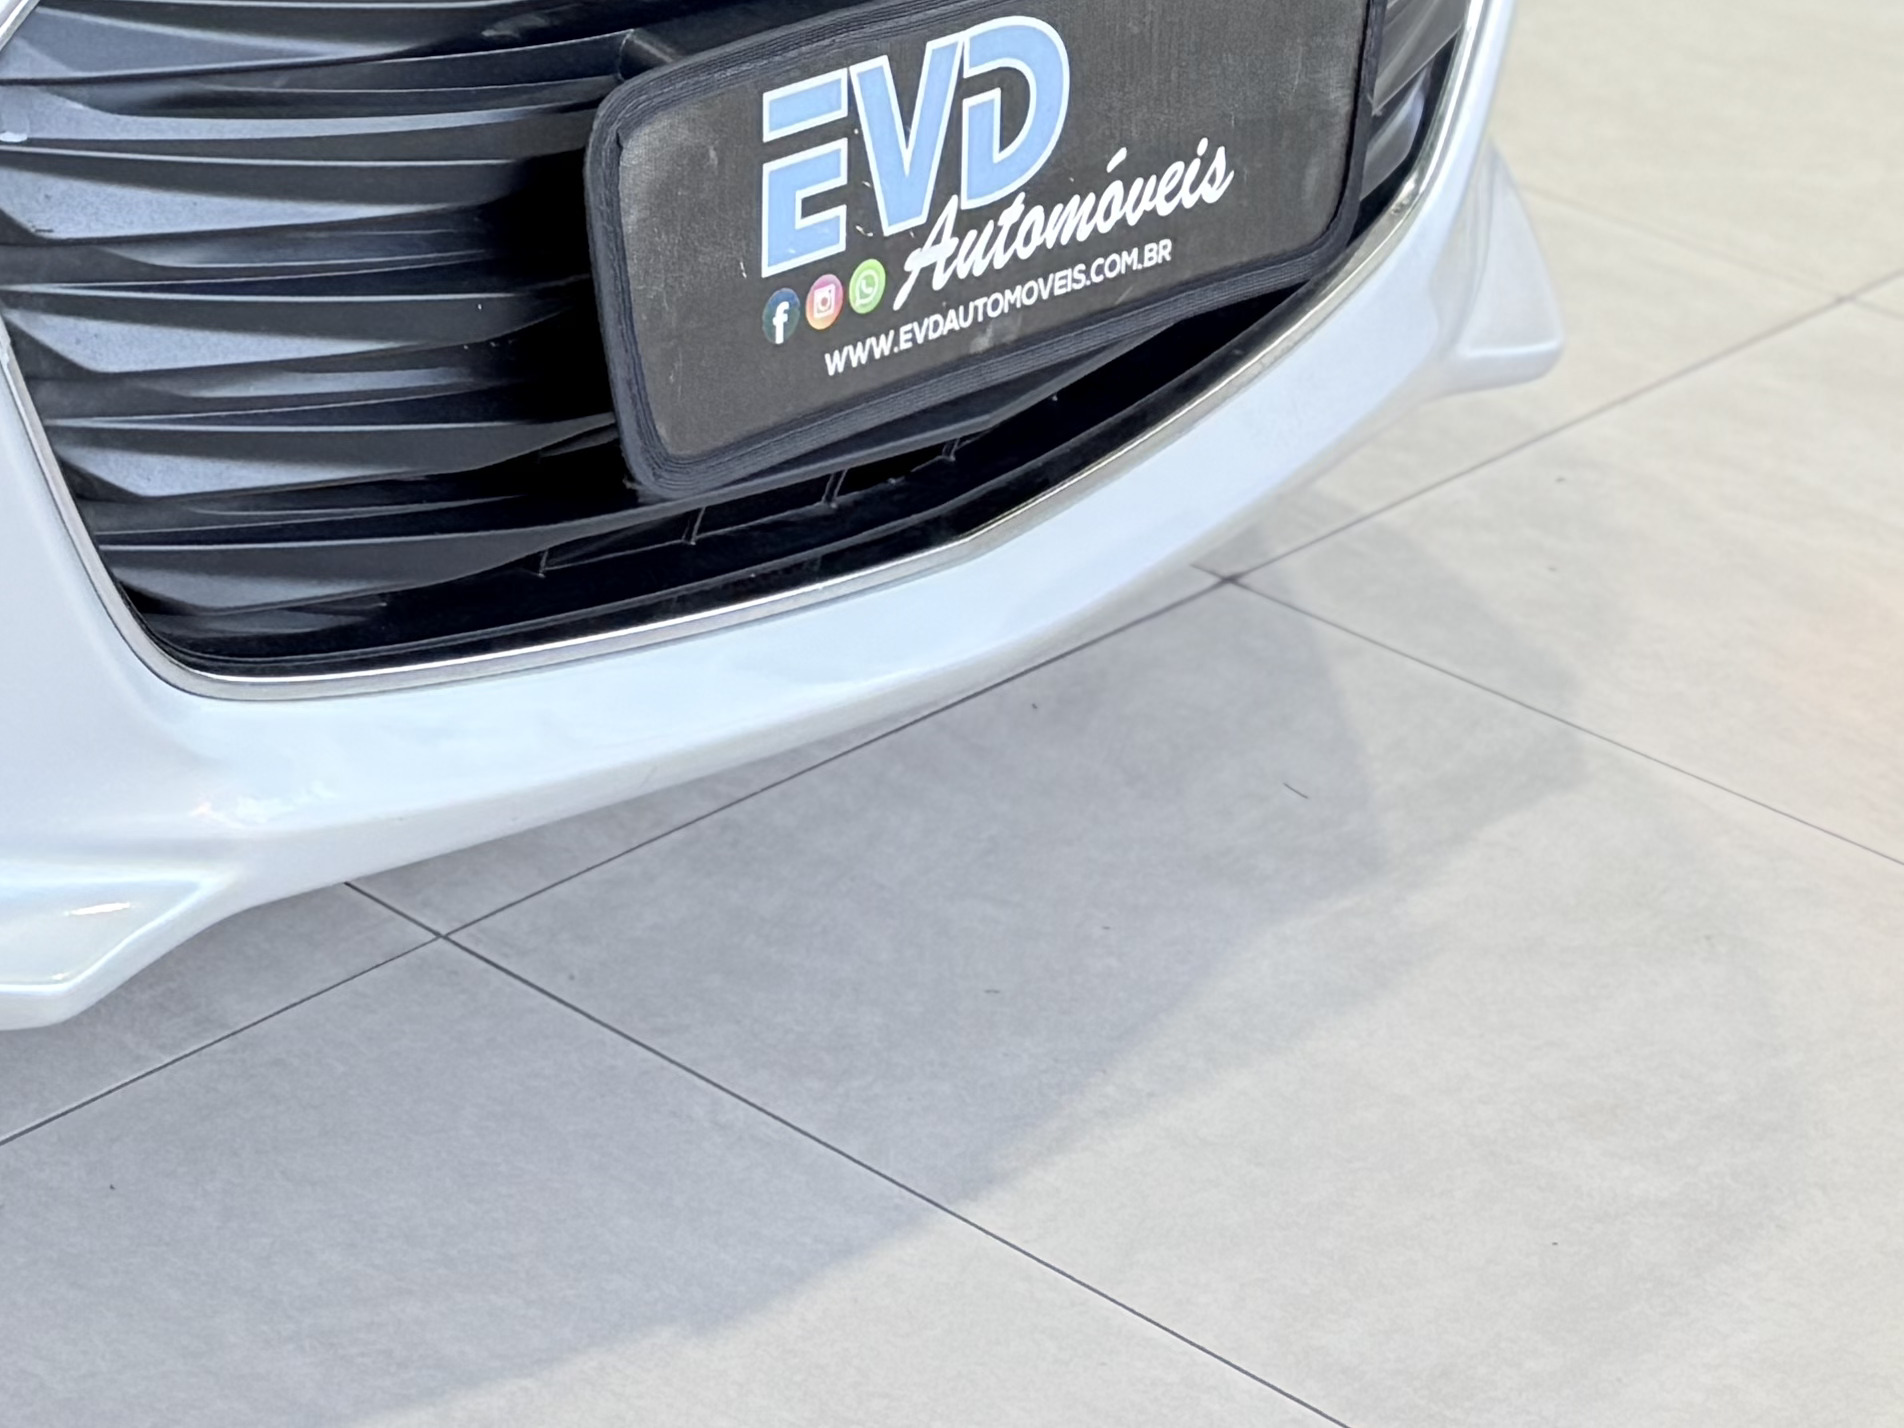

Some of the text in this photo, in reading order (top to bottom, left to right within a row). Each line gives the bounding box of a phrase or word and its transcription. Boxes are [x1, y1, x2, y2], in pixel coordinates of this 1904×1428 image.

[762, 15, 1071, 278] EVD
[894, 138, 1235, 310] Automóveis
[824, 238, 1173, 377] WWW.EVDAUTOMOVEIS.COM.BR
